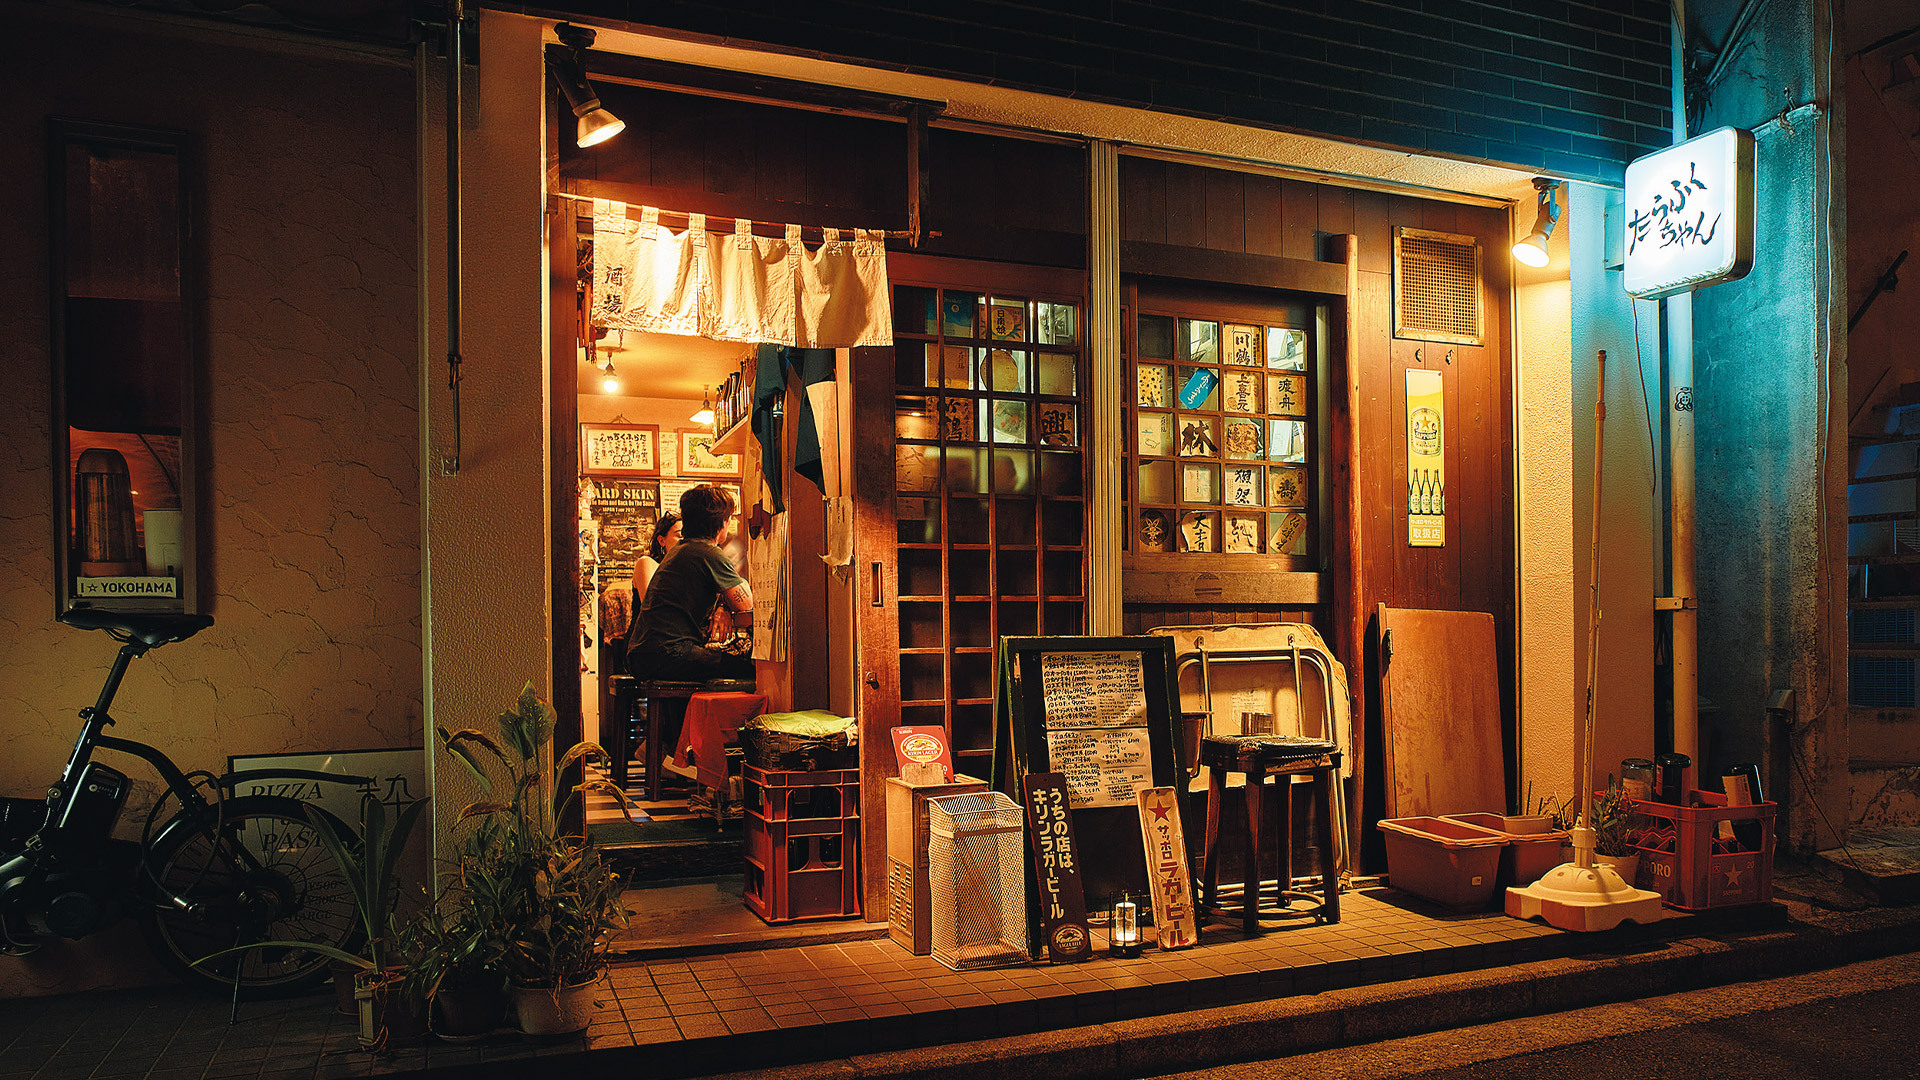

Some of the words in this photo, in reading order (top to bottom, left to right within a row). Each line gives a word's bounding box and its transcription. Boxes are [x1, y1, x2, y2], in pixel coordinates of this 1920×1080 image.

[1628, 161, 1708, 256] たらふく
[1659, 211, 1722, 250] ちゃん
[1235, 373, 1251, 412] 上喜元
[1278, 378, 1297, 411] 渡舟
[595, 487, 620, 499] ARD
[623, 488, 655, 500] SKIN
[1235, 469, 1252, 504] 獺祭
[1412, 528, 1441, 539] 取扱店
[81, 582, 84, 593] I
[101, 582, 174, 593] YOKOHAMA
[251, 782, 323, 799] PIZZA
[263, 830, 322, 851] PAST
[1049, 787, 1075, 875] うちの店は、
[1032, 788, 1065, 920] キリンラガービール
[1156, 825, 1190, 947] サッポロラガービール
